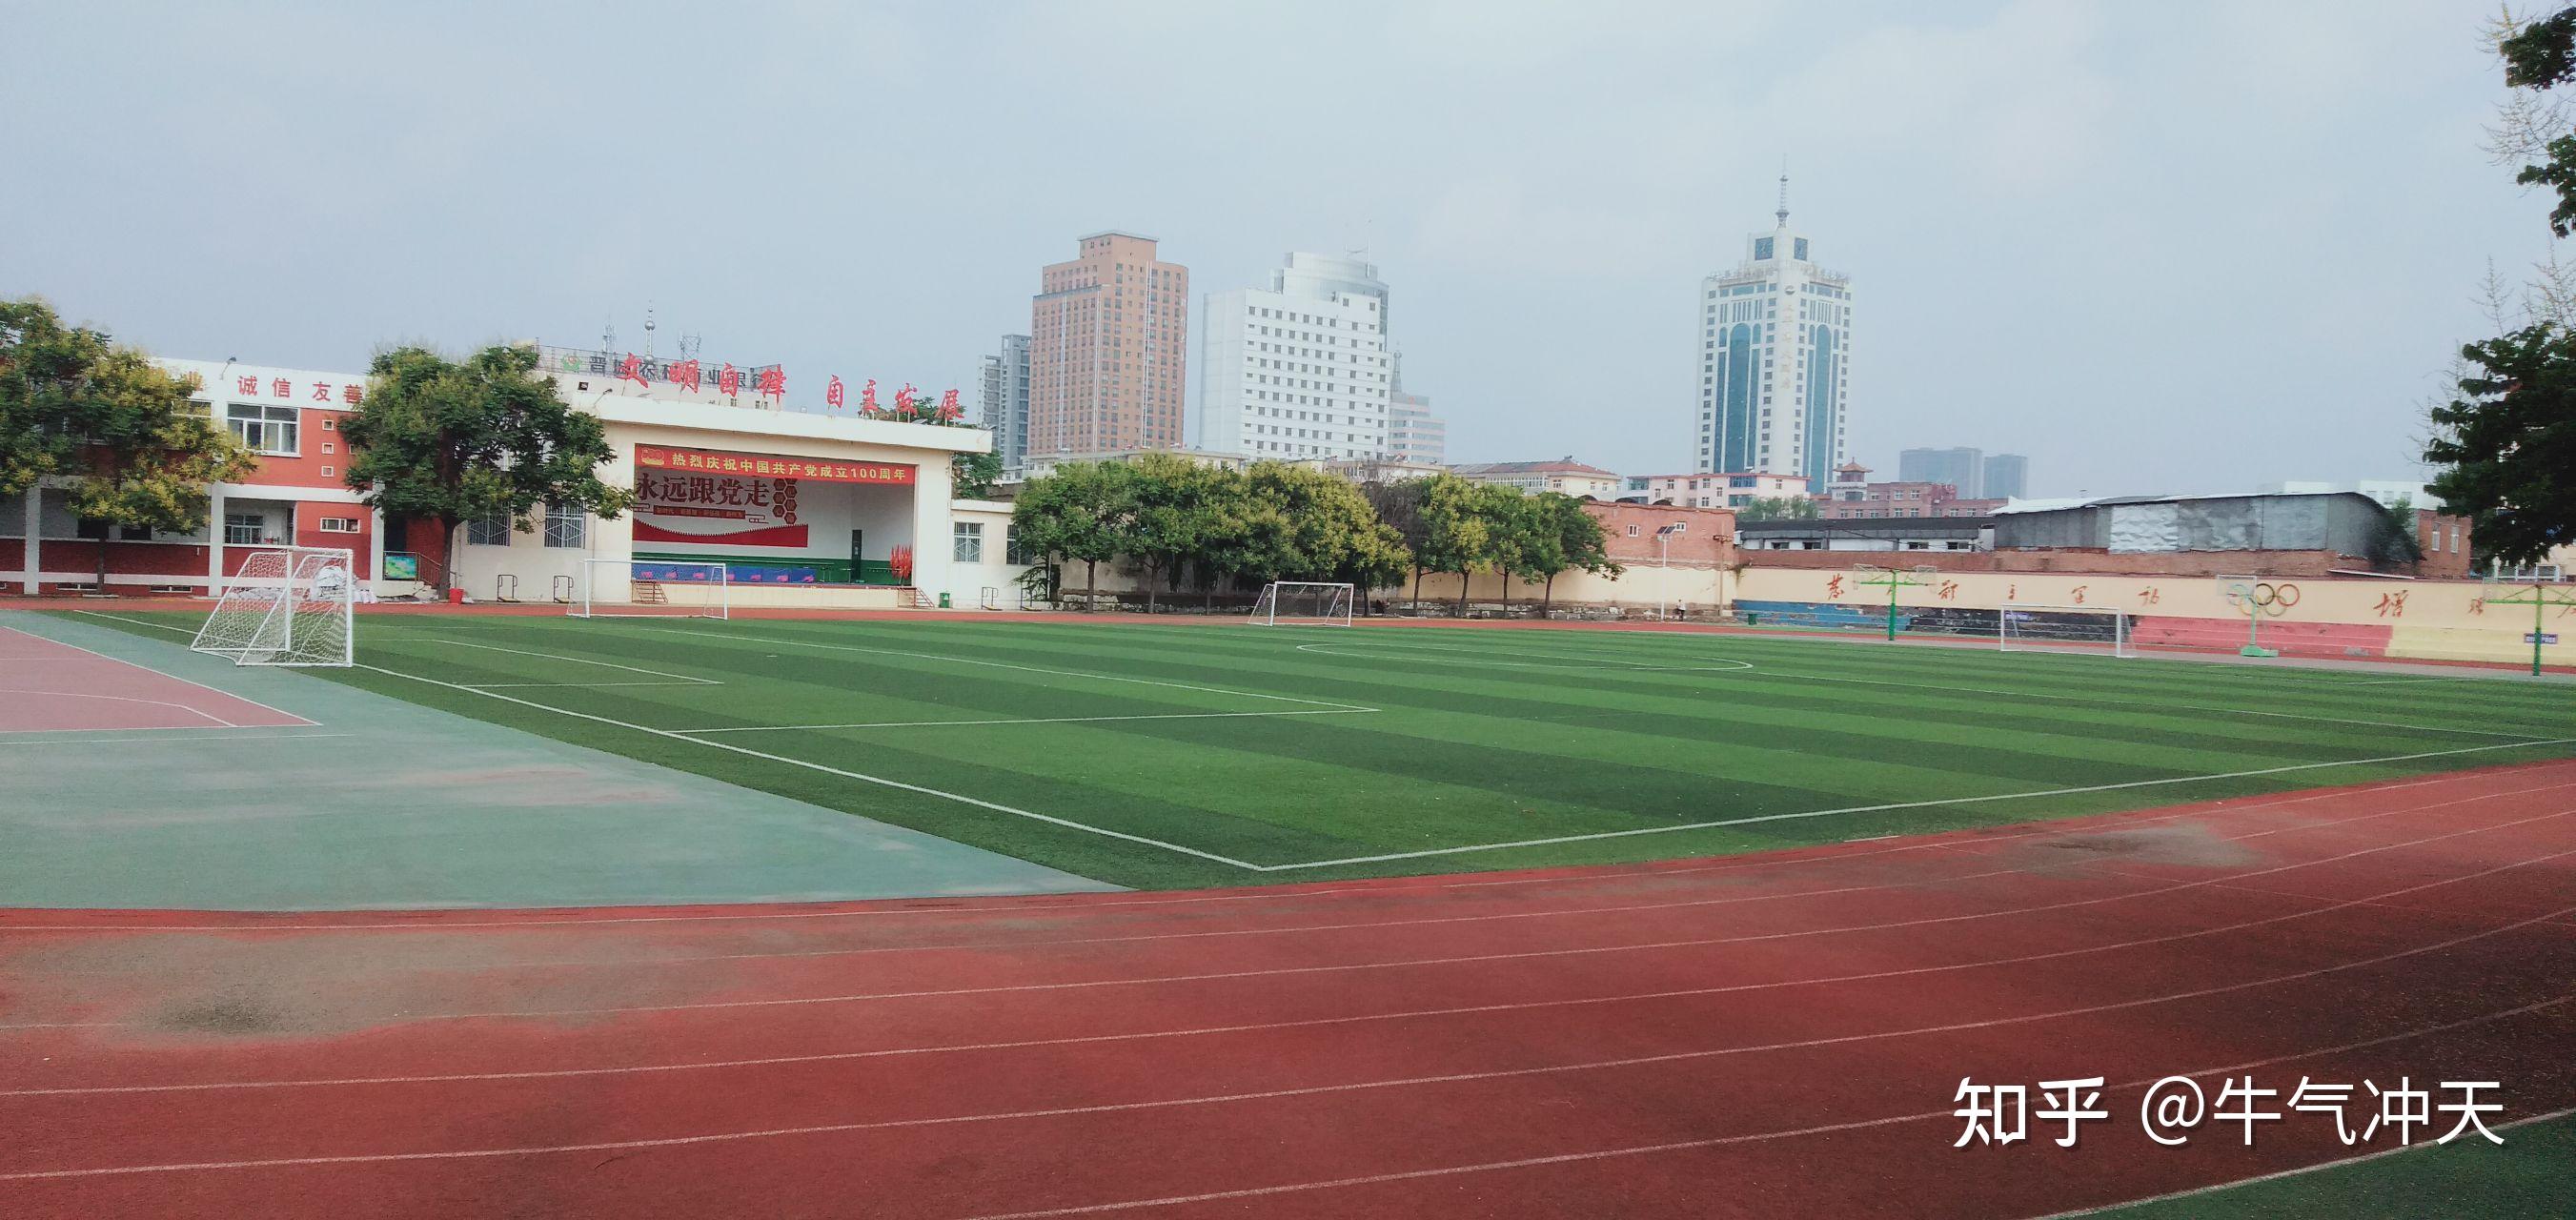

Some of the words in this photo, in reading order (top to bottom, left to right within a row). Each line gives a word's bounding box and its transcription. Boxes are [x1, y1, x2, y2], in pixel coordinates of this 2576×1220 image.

[672, 453, 906, 480] 热烈庆祝中国共产党成立100周年
[635, 473, 770, 507] 永远跟党走
